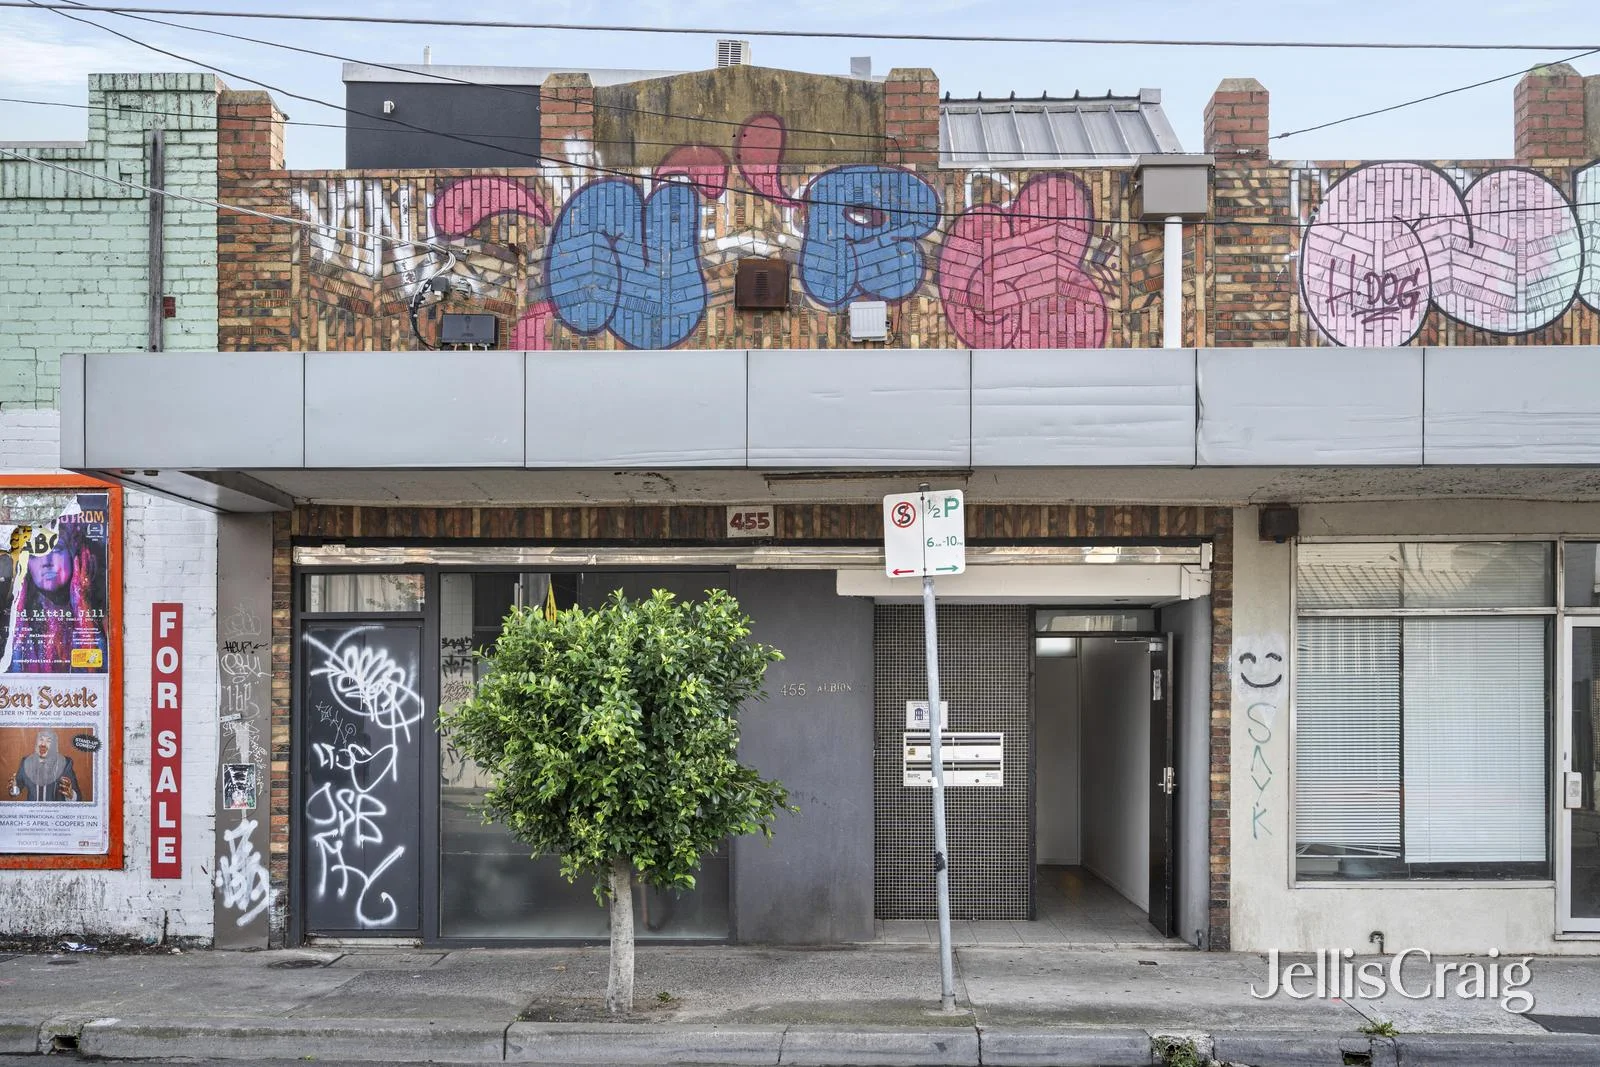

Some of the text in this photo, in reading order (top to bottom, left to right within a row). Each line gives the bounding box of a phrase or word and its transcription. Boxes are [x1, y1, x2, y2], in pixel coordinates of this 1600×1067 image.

[730, 512, 770, 530] 455
[33, 609, 72, 618] Little
[78, 609, 105, 618] Jill
[0, 684, 98, 709] Ben Searle
[780, 681, 852, 697] 455 ALBION
[75, 737, 99, 746] STAND-UP
[156, 611, 179, 864] FOR SALE
[75, 742, 97, 750] COMEDY
